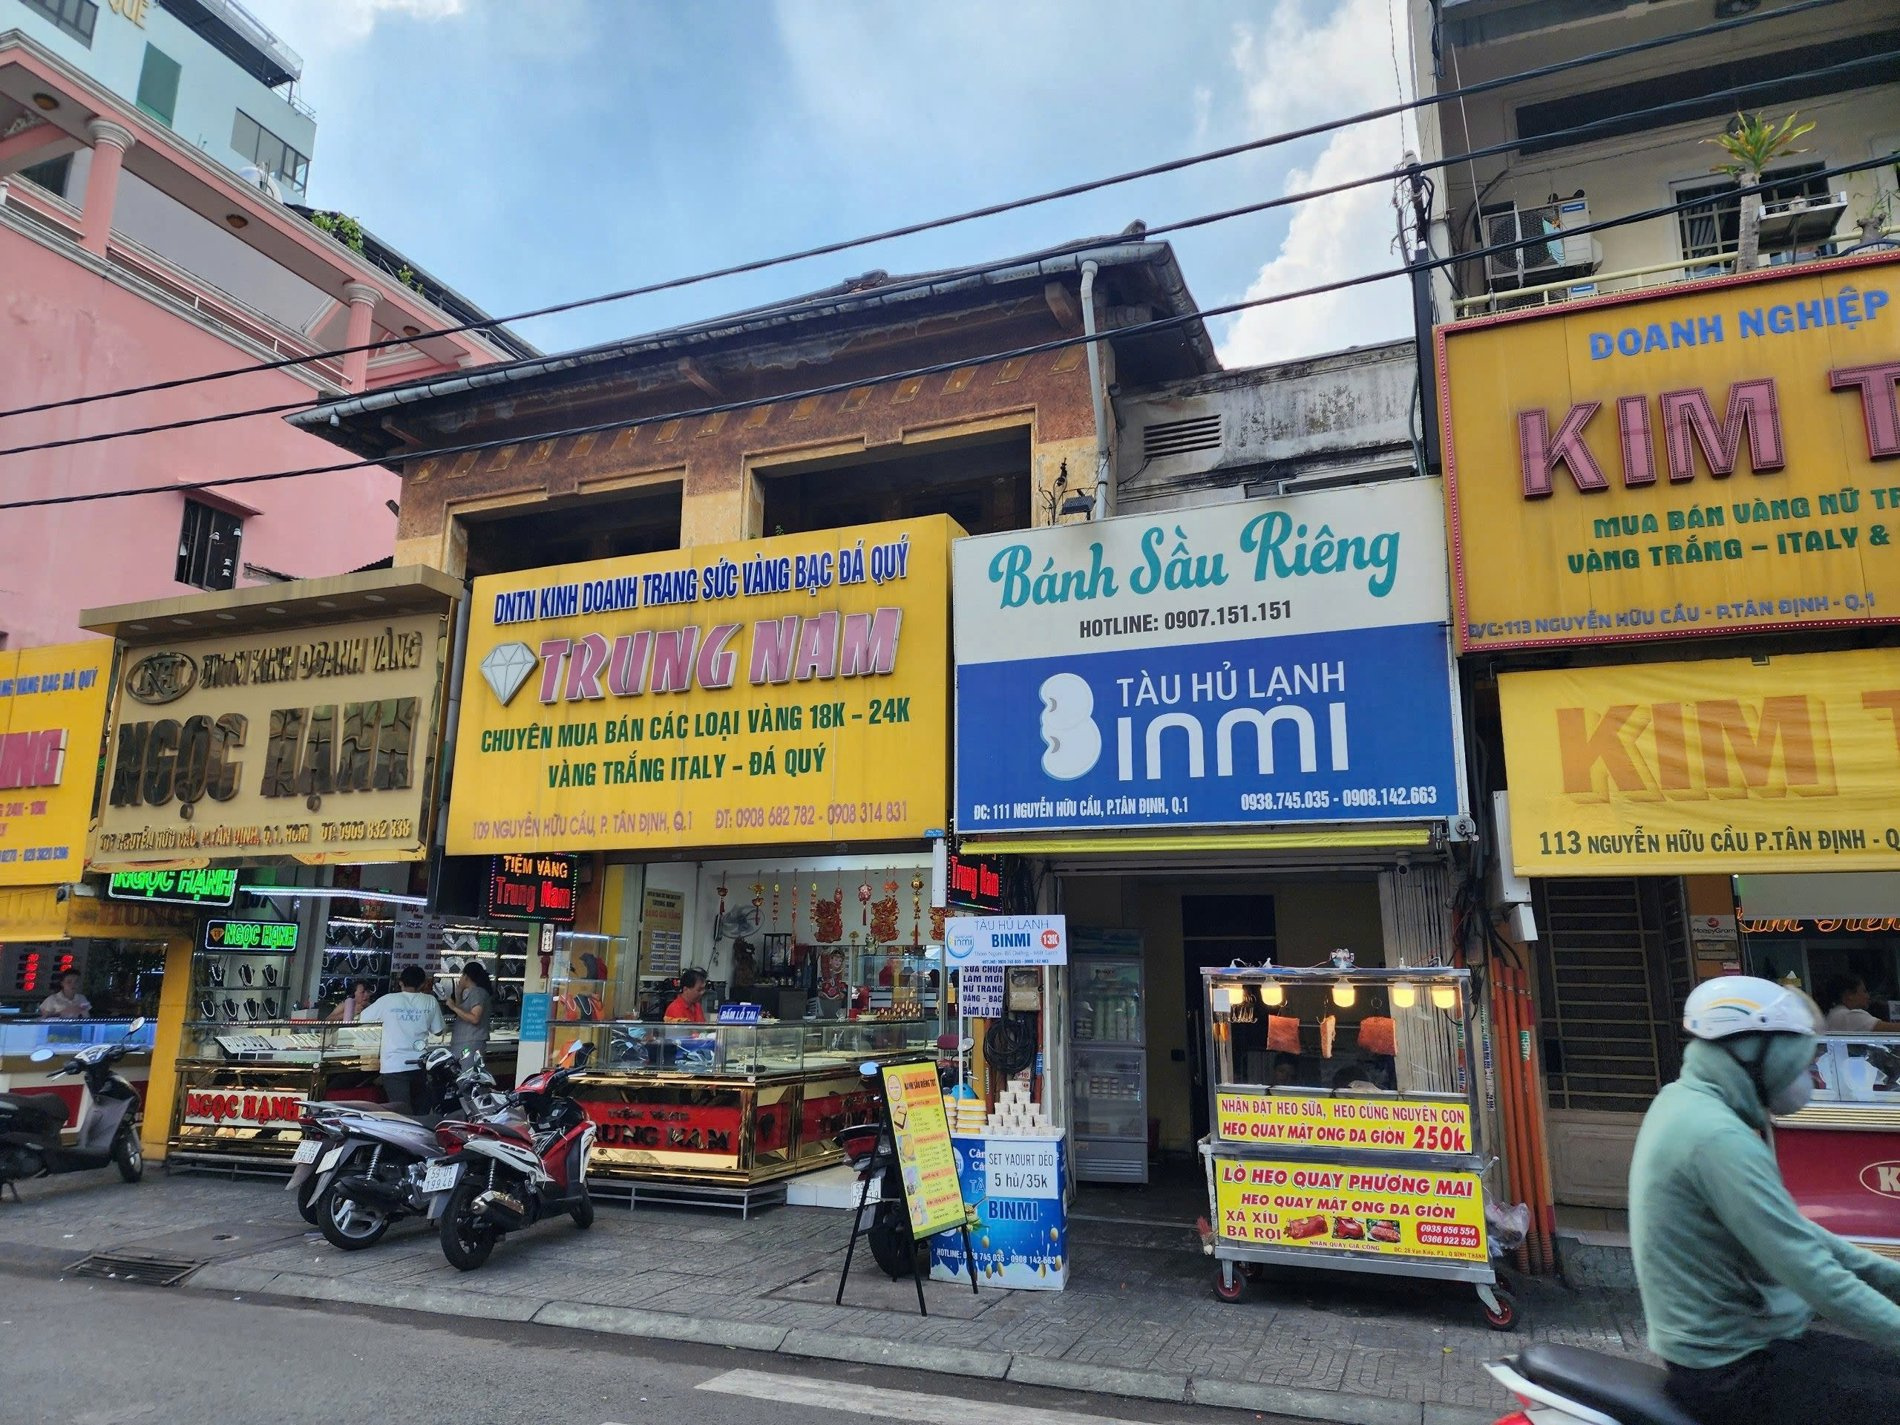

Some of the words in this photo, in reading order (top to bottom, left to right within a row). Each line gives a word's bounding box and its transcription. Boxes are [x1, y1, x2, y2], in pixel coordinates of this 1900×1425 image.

[1589, 312, 1724, 361] DOANH
[1739, 285, 1891, 340] NGHIỆP
[1517, 377, 1786, 500] KIM
[1594, 513, 1659, 539] MUA
[1667, 501, 1725, 531] BÁN
[1733, 494, 1811, 524] VÀNG
[1819, 486, 1860, 514] NỮ
[988, 543, 1118, 610] Bánh
[1130, 524, 1229, 596] Sầu
[1239, 510, 1401, 599] Riêng
[1567, 544, 1640, 574] VÀNG
[1648, 534, 1743, 566] TRẮNG
[1777, 527, 1859, 556] ITALY
[1869, 524, 1890, 546] &
[493, 591, 537, 624] DNTN
[539, 583, 578, 619] KINH
[581, 576, 639, 615] DOANH
[642, 567, 699, 607] TRANG
[701, 557, 739, 601] SỨC
[741, 553, 791, 597] VÀNG
[793, 552, 832, 597] BẠC
[838, 539, 865, 583] ĐÁ
[870, 534, 911, 584] QUÝ
[1079, 613, 1159, 638] HOTLINE:
[1164, 600, 1292, 632] 0907.151.151
[1535, 609, 1612, 634] NGUYỄN
[1616, 608, 1655, 628] HỮU
[1660, 602, 1700, 624] CẦU
[1716, 600, 1773, 620] P.TÂN
[1778, 595, 1829, 618] ĐỊNH
[300, 638, 368, 680] DOANH
[372, 627, 422, 673] VÀNG
[538, 622, 743, 705] TRUNG
[748, 607, 902, 686] NAM
[1116, 669, 1181, 708] TÀU
[1191, 661, 1237, 702] HỦ
[1248, 660, 1346, 704] LẠNH
[480, 719, 552, 753] CHUYÊN
[557, 721, 599, 748] MUA
[604, 711, 644, 744] BÁN
[649, 706, 689, 741] CÁC
[694, 709, 740, 742] LOẠI
[746, 698, 803, 734] VÀNG
[809, 703, 845, 729] 18K
[868, 697, 911, 726] 24K
[1556, 695, 1834, 802] KIM
[109, 713, 248, 822] NGỌC
[548, 756, 598, 789] VÀNG
[603, 747, 666, 785] TRẮNG
[670, 754, 727, 780] ITALY
[749, 746, 775, 777] ĐÁ
[785, 741, 827, 776] QUÝ
[974, 804, 990, 819] ĐC:
[993, 803, 1010, 819] 111
[1013, 796, 1053, 818] NGUYỄN
[1056, 797, 1077, 817] HỮU
[1080, 794, 1104, 817] CẦU,
[1107, 795, 1136, 815] P.TÂN
[1139, 796, 1169, 818] ĐỊNH,
[1172, 796, 1188, 813] Q.1
[1241, 790, 1330, 811] 0938.745.035
[1343, 785, 1437, 807] 0908.142.663
[473, 820, 490, 840] 109
[543, 813, 567, 836] HỮU
[613, 810, 636, 833] TÂN
[639, 811, 670, 836] ĐỊNH,
[715, 808, 732, 828] ĐT:
[736, 808, 765, 828] 0908
[768, 806, 790, 826] 682
[793, 805, 815, 825] 782
[827, 803, 856, 825] 0908
[860, 802, 882, 823] 314
[886, 800, 907, 821] 831
[340, 820, 365, 840] 0909
[367, 819, 388, 839] 832
[391, 818, 411, 838] 838
[1540, 830, 1582, 855] 113
[1588, 826, 1660, 854] NGUYỄN
[1666, 829, 1704, 853] HỮU
[1711, 824, 1748, 852] CẦU
[1756, 826, 1813, 851] P.TÂN
[1818, 829, 1866, 855] ĐỊNH
[503, 854, 533, 877] TIỆM
[537, 857, 568, 879] VÀNG
[951, 855, 977, 900] Trung
[496, 875, 535, 912] Trung
[540, 880, 571, 909] Nam
[224, 924, 260, 949] NGỌC
[992, 933, 1030, 948] BINMI
[977, 984, 1003, 993] TRANG
[187, 1093, 240, 1123] NGỌC
[243, 1093, 301, 1124] HẠNH
[1221, 1096, 1249, 1114] NHẬN
[1277, 1102, 1298, 1116] HEO
[1333, 1104, 1355, 1118] HEO
[1393, 1105, 1437, 1123] NGUYÊN
[1442, 1109, 1465, 1124] CON
[665, 1126, 731, 1150] NAM
[1222, 1121, 1246, 1136] HEO
[1250, 1124, 1285, 1139] QUAY
[1287, 1123, 1314, 1143] MẬT
[1317, 1127, 1346, 1141] ONG
[1349, 1128, 1367, 1142] DA
[1413, 1125, 1466, 1152] 250k
[989, 1153, 1002, 1165] SET
[1005, 1153, 1035, 1166] YAOURT
[995, 1173, 1001, 1187] 5
[1222, 1163, 1247, 1182] LÒ
[1251, 1169, 1287, 1186] HEO
[1292, 1171, 1344, 1190] QUAY
[1348, 1173, 1431, 1197] PHƯƠNG
[1434, 1179, 1474, 1198] MAI
[988, 1200, 1038, 1221] BINMI
[1226, 1208, 1246, 1222] XÁ
[1252, 1211, 1279, 1225] XÍU
[1241, 1194, 1269, 1206] HEO
[1274, 1196, 1313, 1210] QUAY
[1317, 1196, 1346, 1214] MẬT
[1351, 1201, 1385, 1215] ONG
[1389, 1203, 1410, 1216] DA
[1227, 1225, 1247, 1238] BA
[1254, 1227, 1281, 1243] RỌI
[1421, 1224, 1442, 1233] 0938
[1443, 1226, 1458, 1234] 656
[1460, 1227, 1475, 1235] 554
[1443, 1236, 1459, 1245] 922
[1461, 1238, 1477, 1246] 520
[936, 1248, 961, 1258] HOTLINE:
